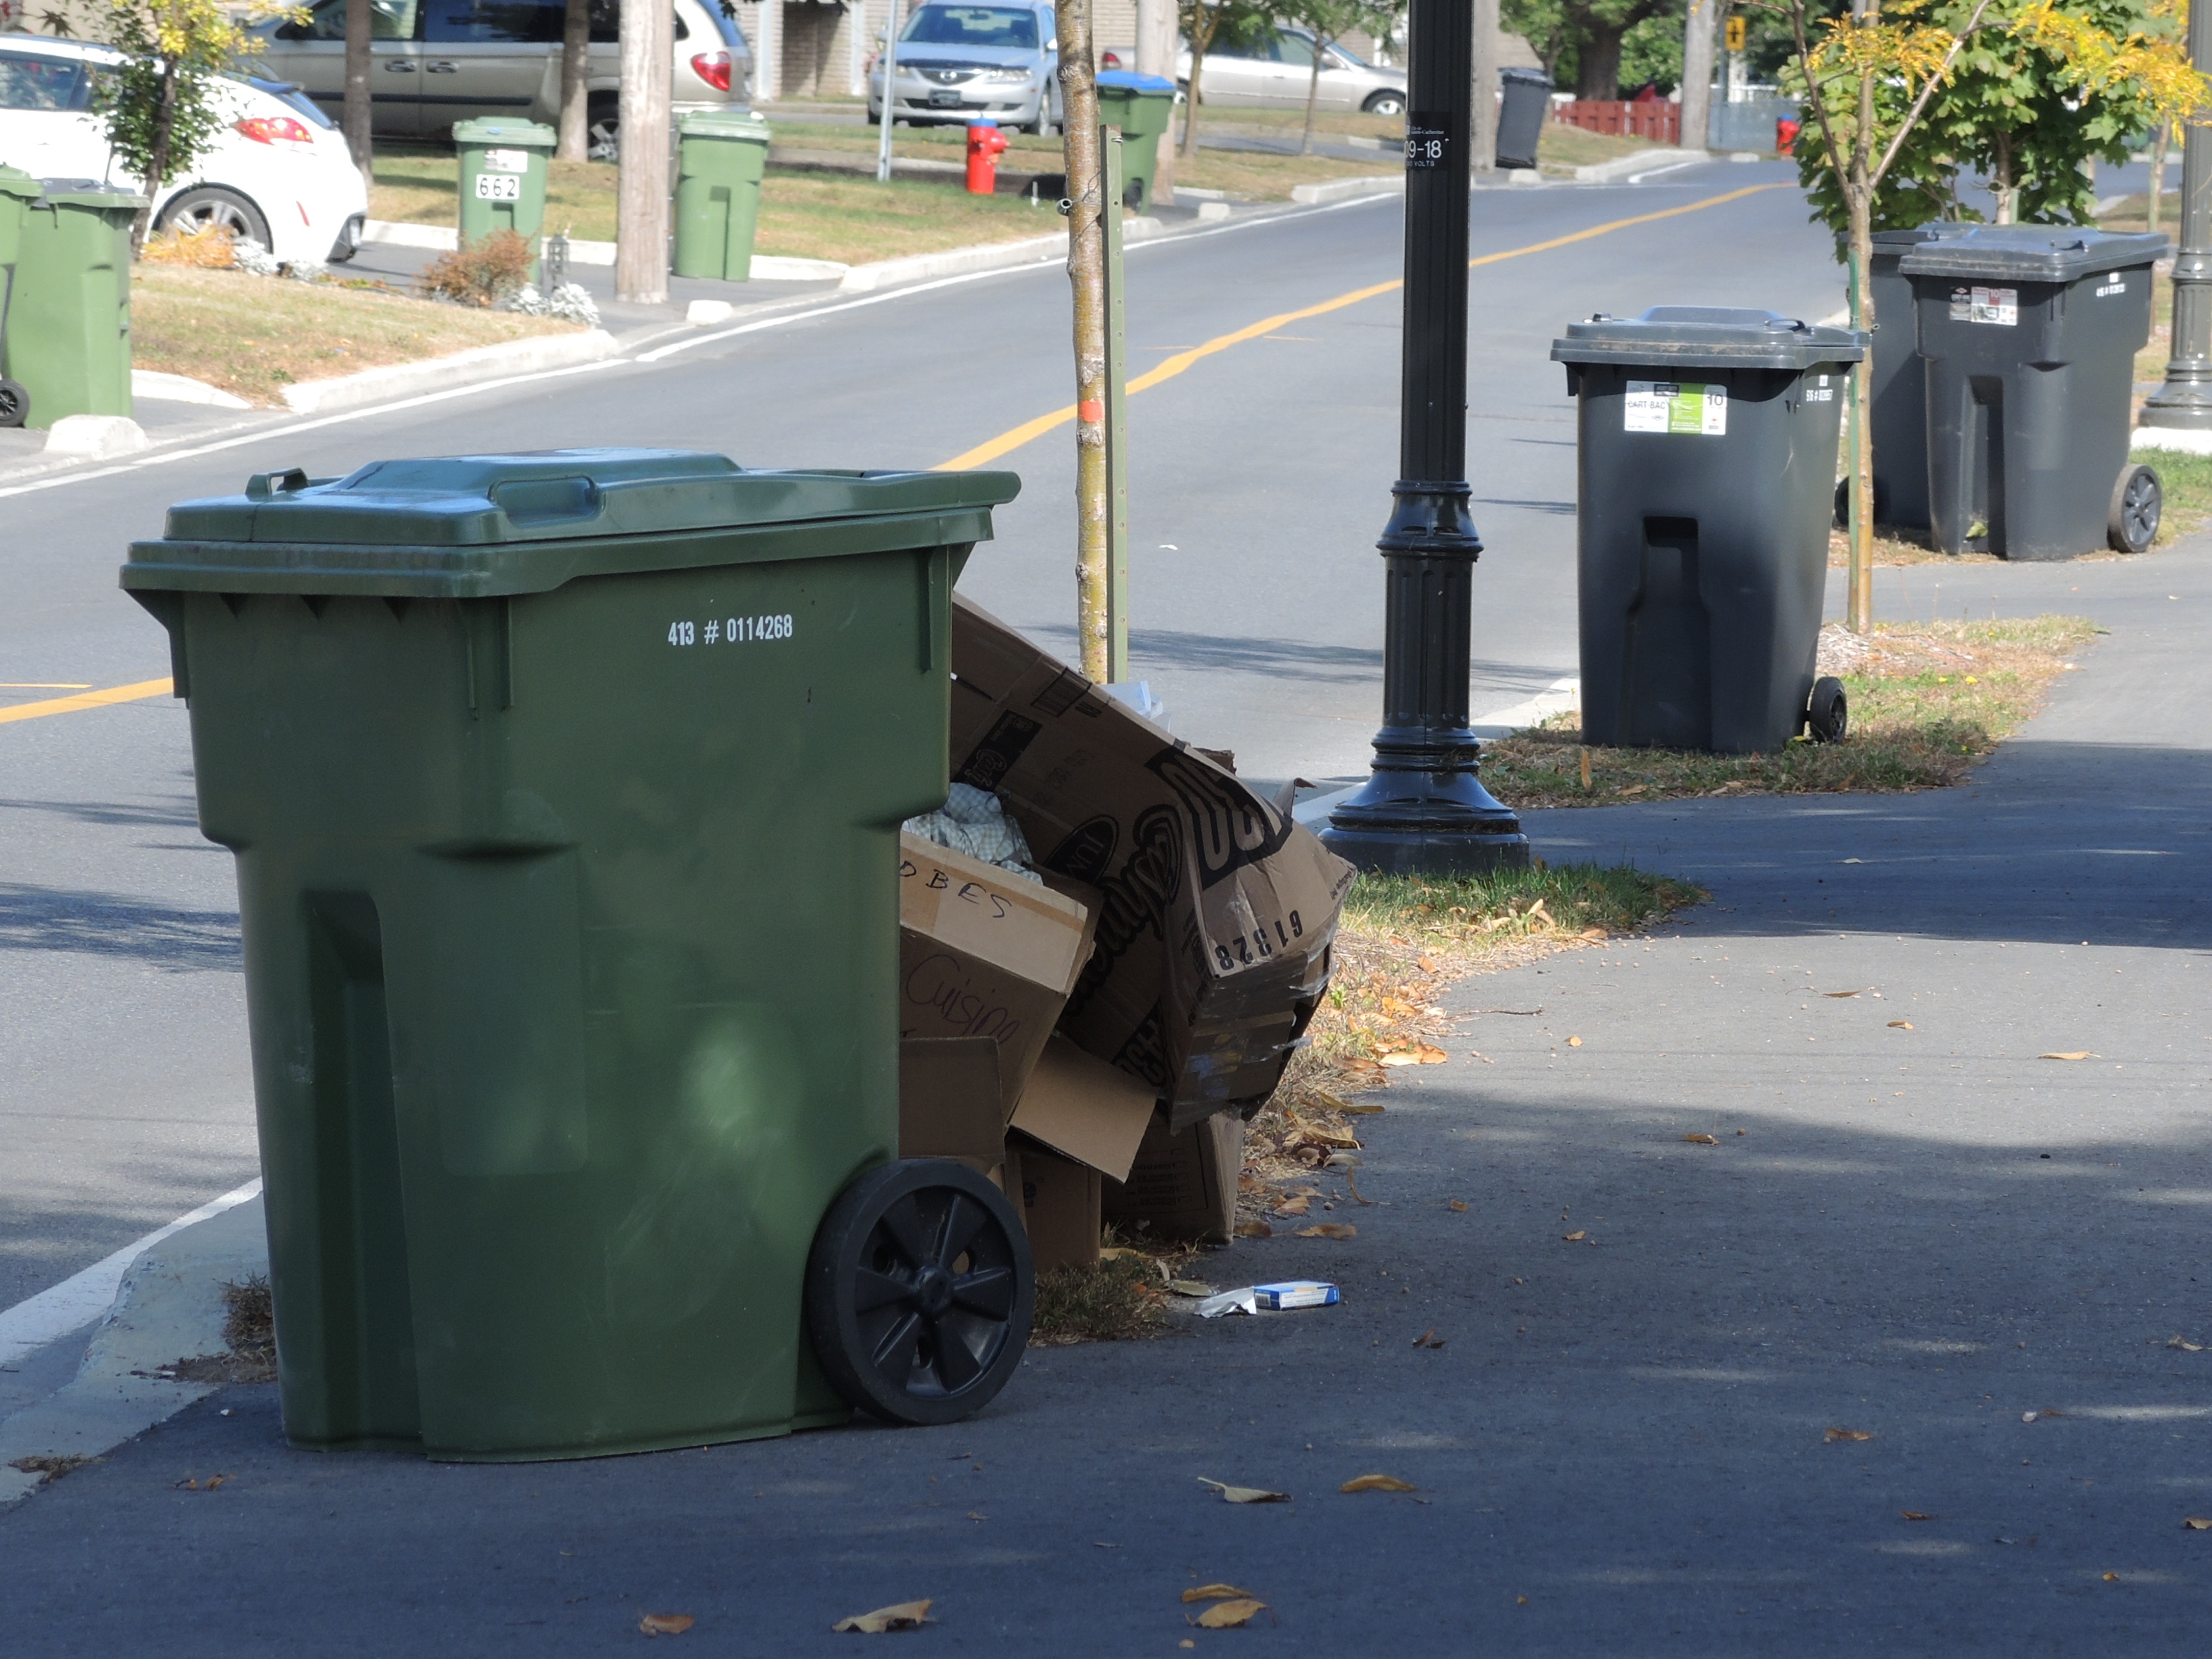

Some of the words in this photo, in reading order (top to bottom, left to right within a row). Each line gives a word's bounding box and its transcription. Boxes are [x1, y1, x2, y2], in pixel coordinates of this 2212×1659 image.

[479, 177, 515, 197] 662
[1707, 393, 1724, 406] 10
[668, 621, 695, 646] 413
[704, 619, 719, 644] #
[727, 614, 792, 642] 0114268
[1214, 910, 1303, 971] 61328
